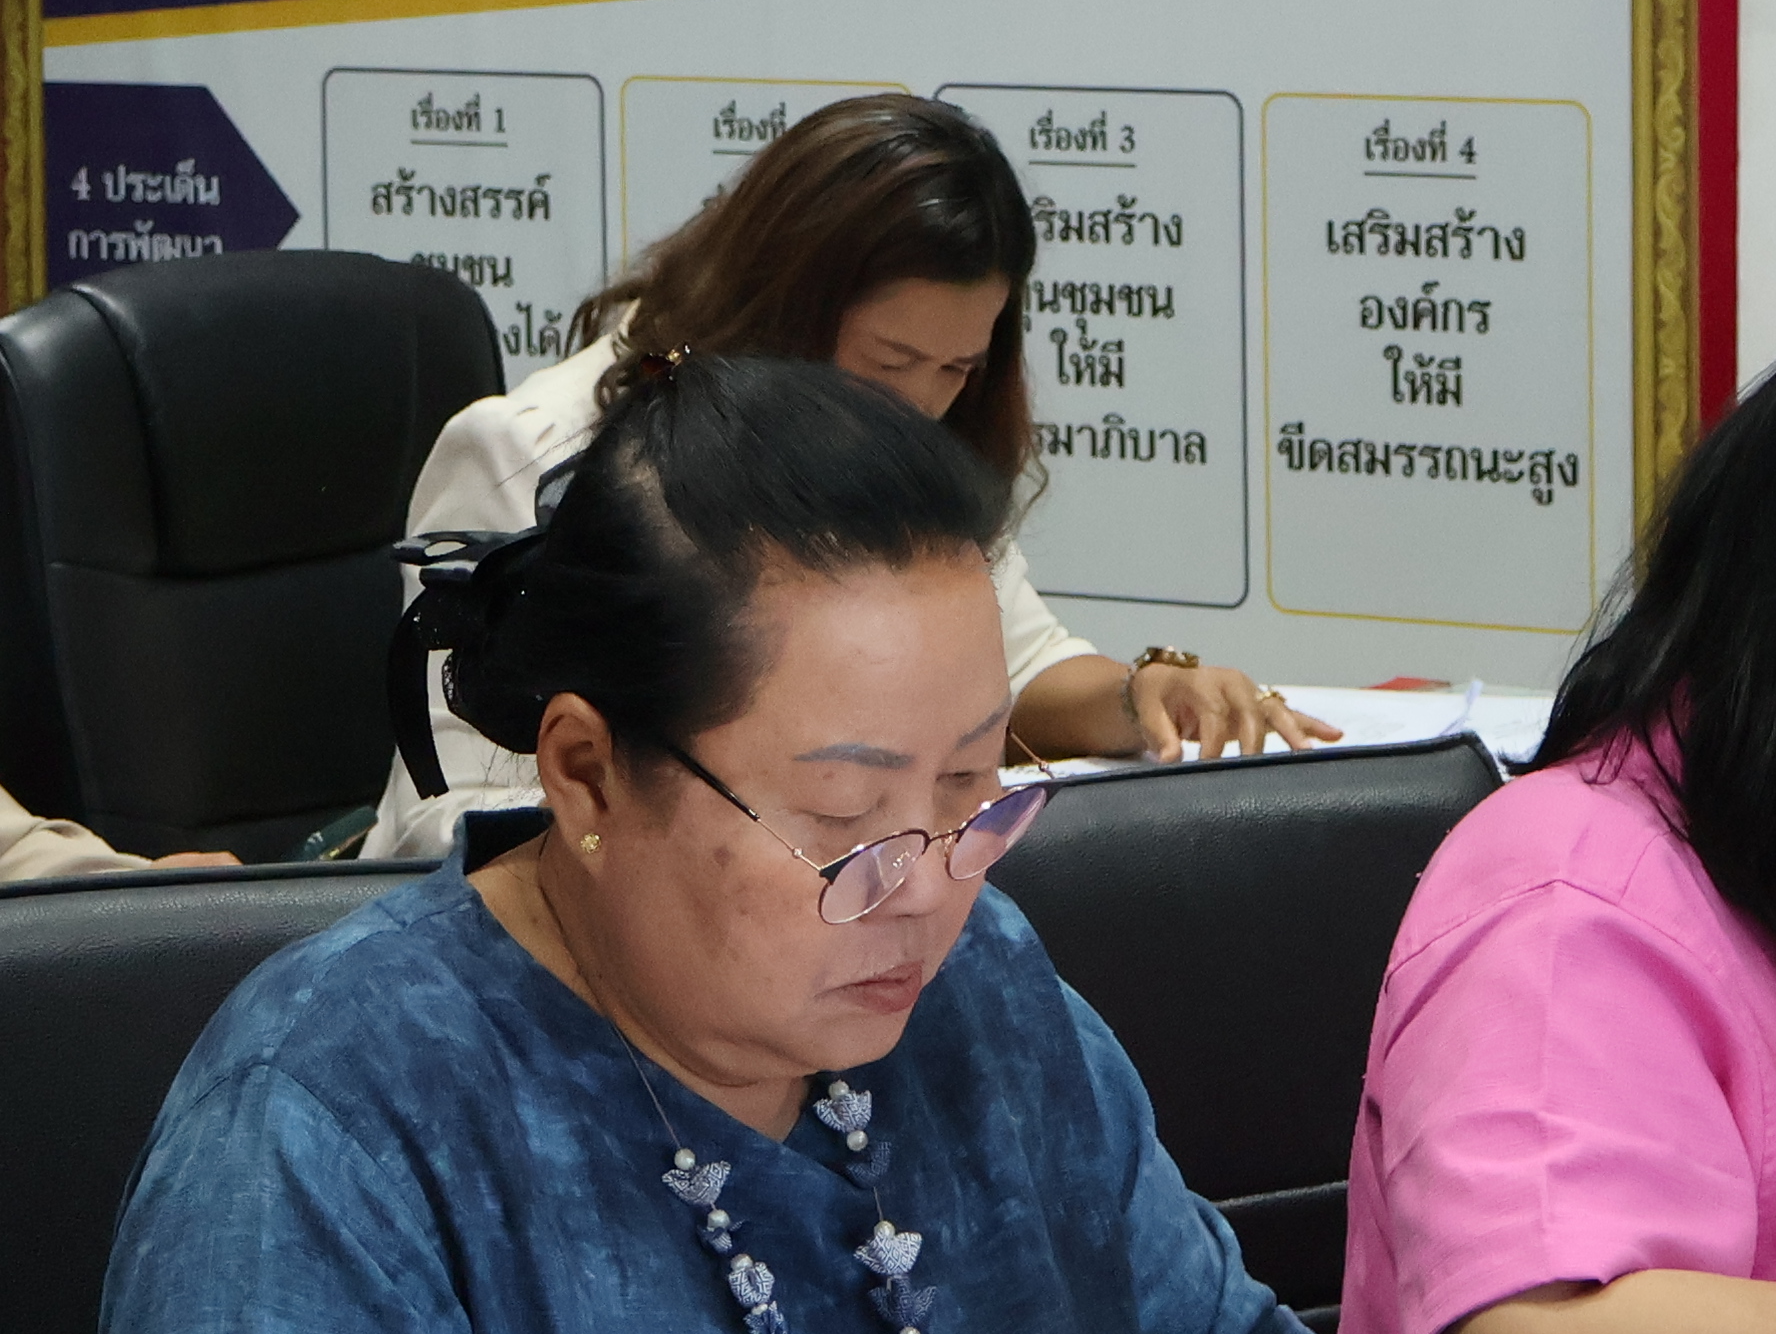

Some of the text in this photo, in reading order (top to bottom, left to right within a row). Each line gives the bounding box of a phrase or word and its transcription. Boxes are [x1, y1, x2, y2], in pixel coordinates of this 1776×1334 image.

[410, 91, 508, 135] เรื่องที่ 1
[1028, 110, 1136, 153] เรื่องที่ 3
[1364, 119, 1478, 165] เรื่องที่ 4
[69, 155, 221, 207] 4 ประเด็น
[370, 167, 553, 223] สร้างสรรค์
[1325, 193, 1526, 262] เสริมสร้าง
[1359, 281, 1493, 335] องค์กร
[1049, 326, 1126, 389] ให้มี
[1382, 343, 1465, 408] ให้มี
[1276, 422, 1581, 507] ขีดสมรรถนะสูง
